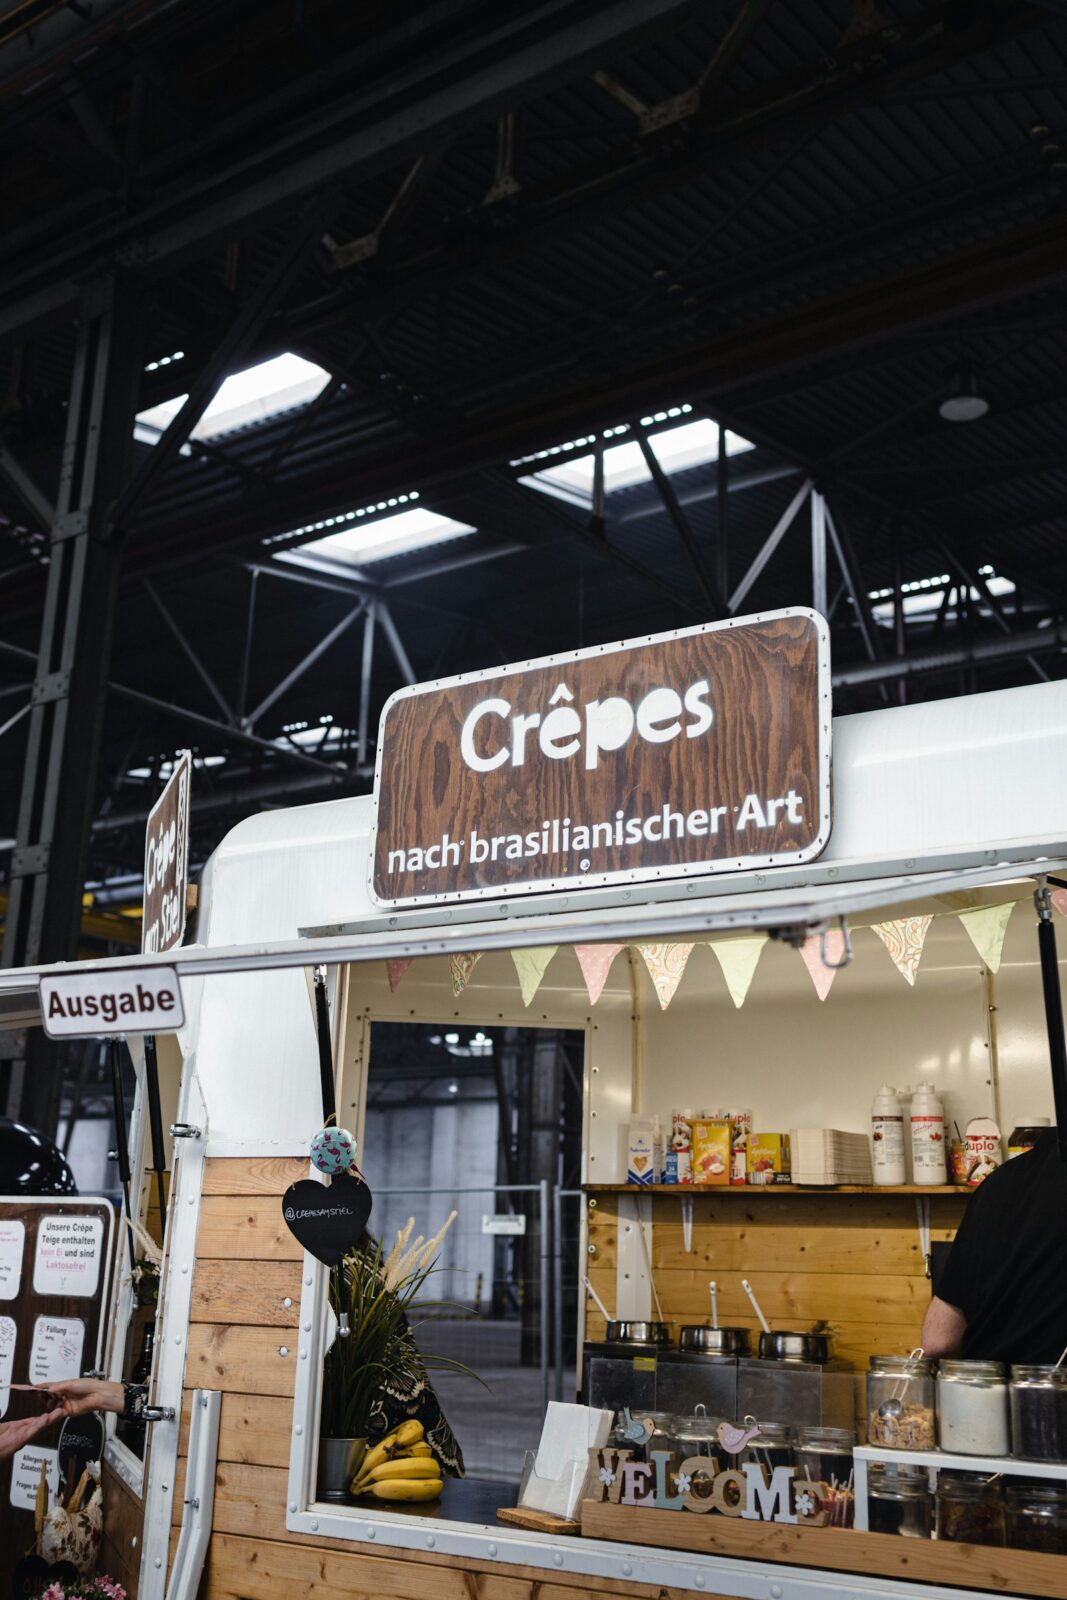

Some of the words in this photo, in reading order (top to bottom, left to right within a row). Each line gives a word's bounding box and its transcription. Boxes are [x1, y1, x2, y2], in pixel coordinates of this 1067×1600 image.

[460, 681, 713, 772] Crêpes
[388, 835, 461, 873] nach
[469, 803, 727, 864] brasilianischer
[736, 790, 803, 830] Art
[48, 984, 175, 1022] Ausgabe
[965, 1140, 995, 1153] duplo
[46, 1222, 71, 1232] Unsere
[42, 1235, 60, 1245] Teige
[62, 1236, 95, 1245] enthalten
[65, 1249, 77, 1257] und
[80, 1250, 95, 1258] sind
[46, 1261, 86, 1271] Laktosefrei
[46, 1325, 67, 1336] Füllung
[588, 1448, 830, 1527] WELCOME
